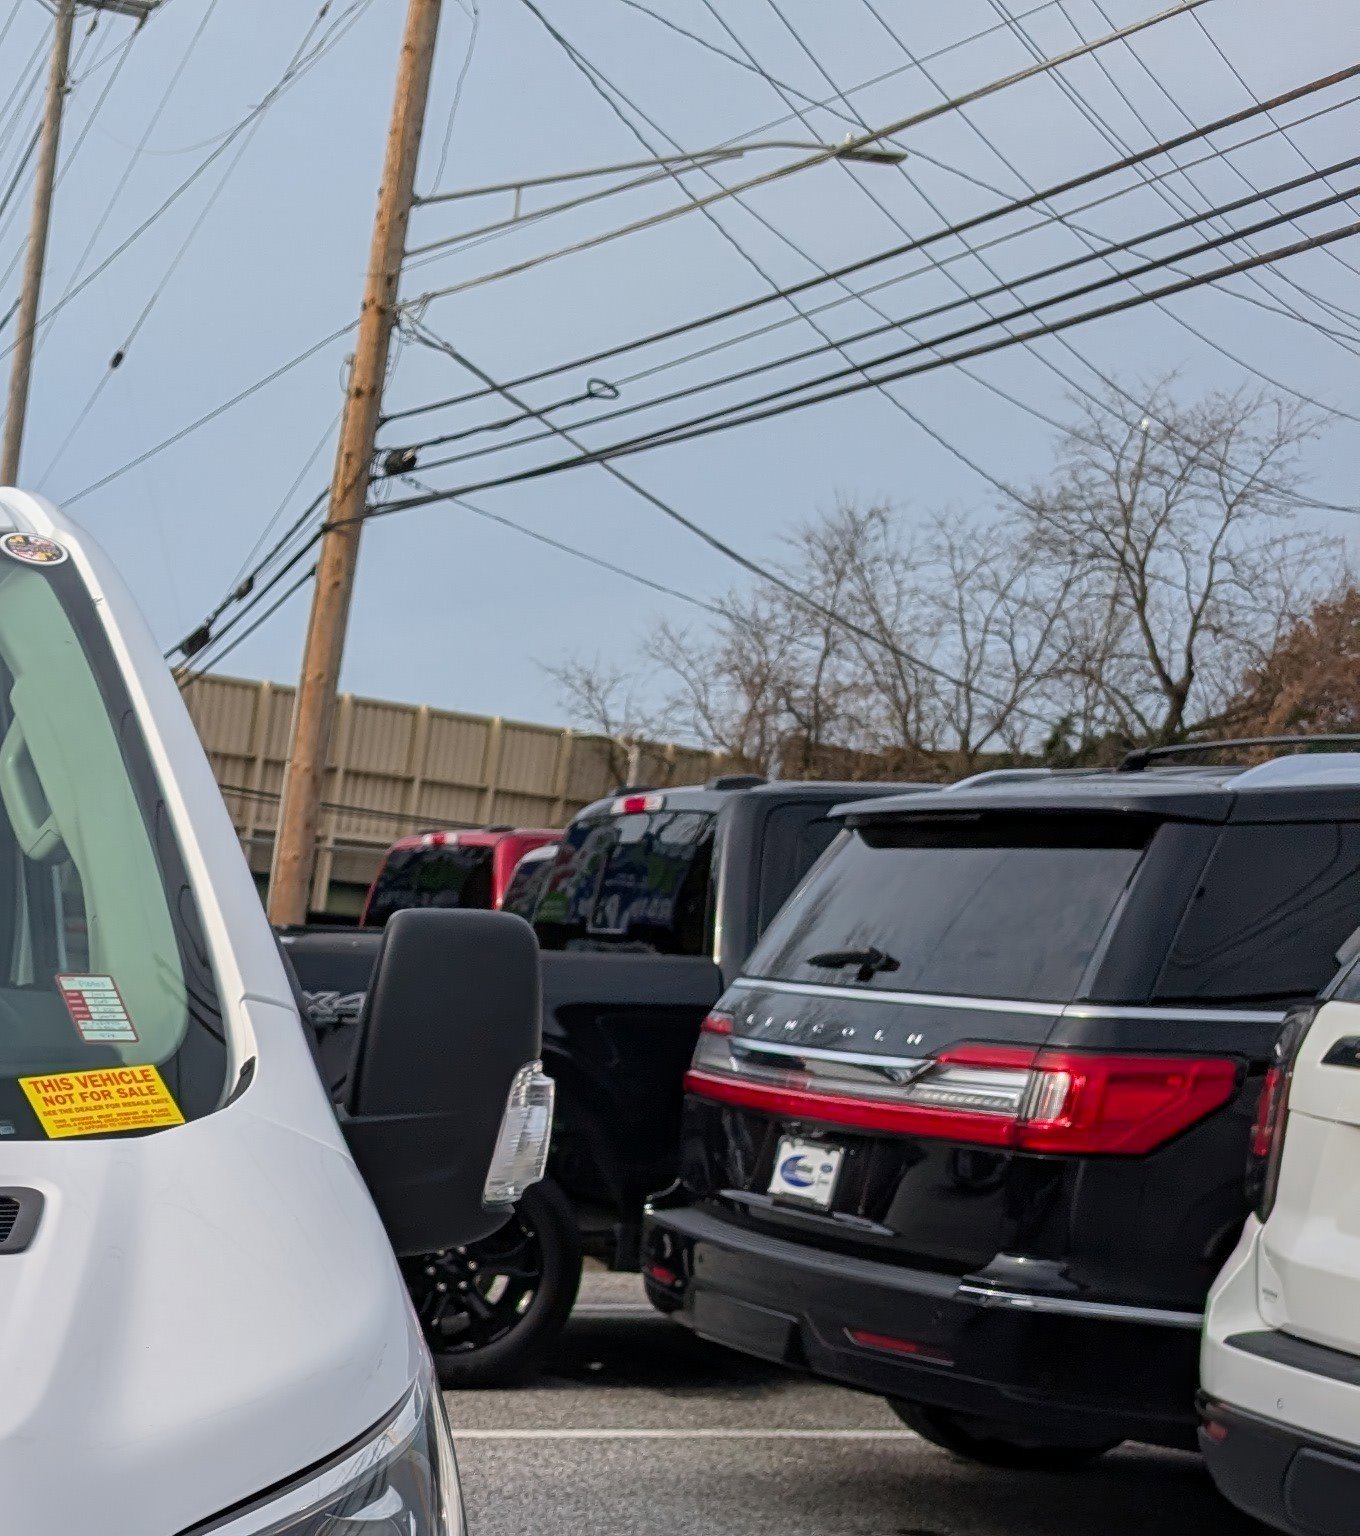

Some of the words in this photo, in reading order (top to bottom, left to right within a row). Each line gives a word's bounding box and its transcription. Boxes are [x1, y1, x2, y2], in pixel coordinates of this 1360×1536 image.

[746, 1013, 923, 1046] LINCOLN
[29, 1077, 73, 1094] THIS
[75, 1069, 155, 1089] VEHICLE
[42, 1093, 74, 1107] NOT
[79, 1090, 113, 1102] FOR
[116, 1085, 159, 1098] SALE
